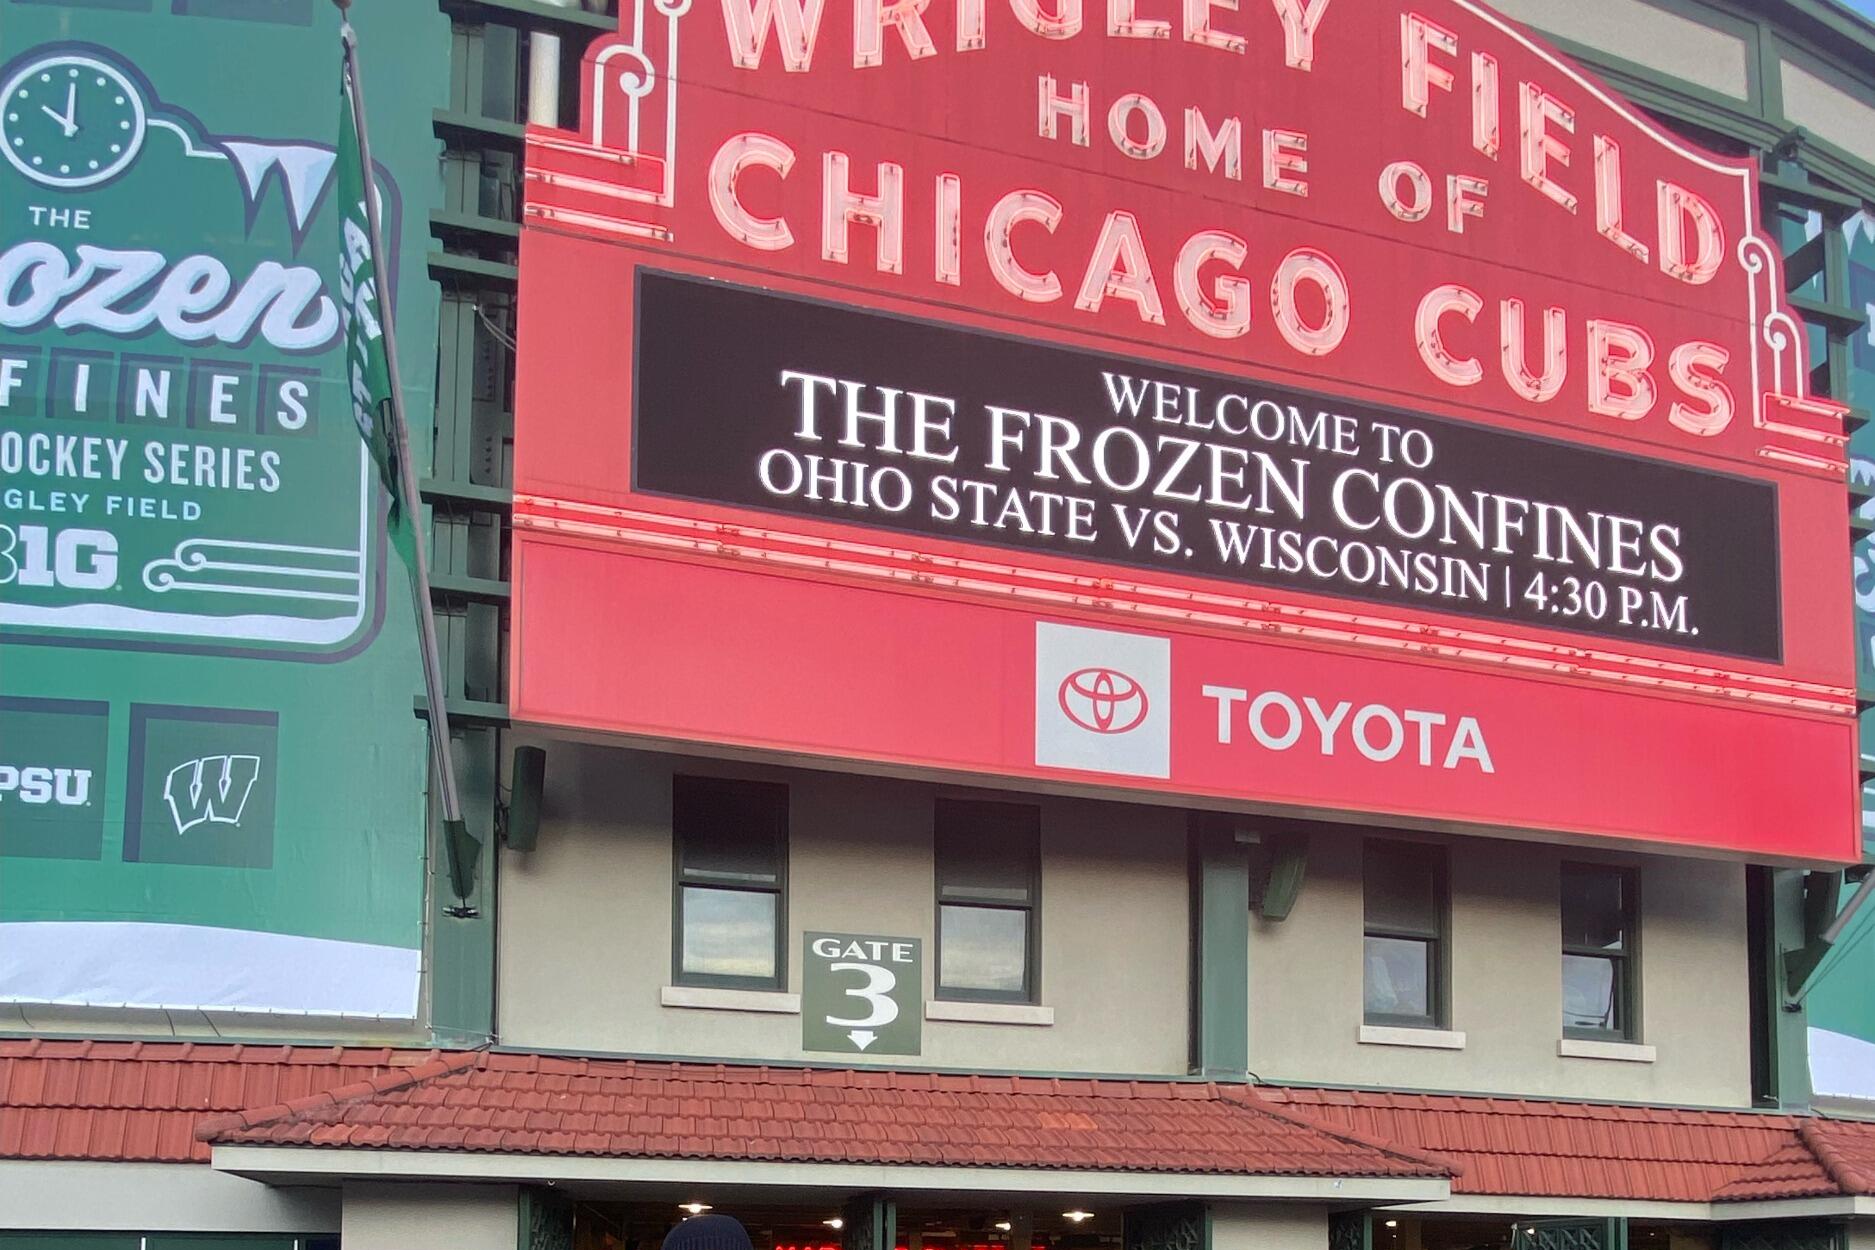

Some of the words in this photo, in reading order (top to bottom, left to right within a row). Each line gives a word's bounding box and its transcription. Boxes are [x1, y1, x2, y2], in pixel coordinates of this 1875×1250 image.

[1038, 71, 1308, 196] HOME
[1378, 160, 1489, 233] OF
[1401, 12, 1725, 284] FIELD
[29, 206, 91, 230] THE
[708, 132, 1350, 356] CHICAGO
[1415, 283, 1736, 436] CUBS
[144, 442, 281, 492] SERIES
[1102, 372, 1360, 457] WELCOME
[1372, 421, 1434, 469] TO
[4, 489, 90, 513] GLEY
[107, 495, 201, 520] FIELD
[781, 370, 959, 463] THE
[984, 404, 1310, 520] FROZEN
[1332, 469, 1684, 583] CONFINES
[758, 448, 912, 512] OHIO
[930, 475, 1098, 543] STATE
[1112, 503, 1194, 558] VS.
[1209, 519, 1492, 603] WISCONSIN
[1523, 572, 1607, 620] 4:30
[1619, 588, 1700, 636] P.M.
[1202, 685, 1495, 774] TOYOTA
[812, 938, 913, 963] GATE
[826, 962, 899, 1027] 3
